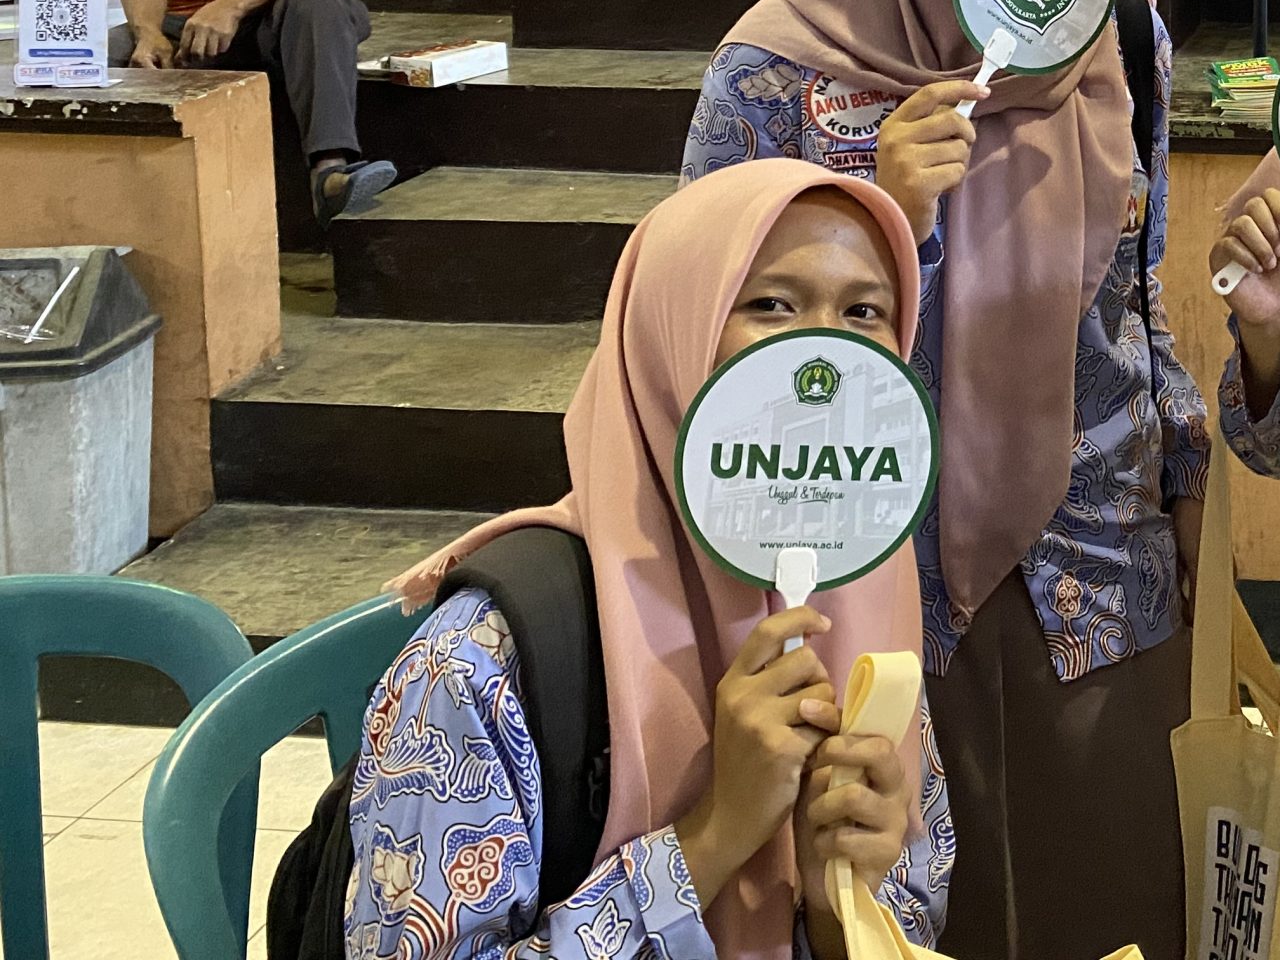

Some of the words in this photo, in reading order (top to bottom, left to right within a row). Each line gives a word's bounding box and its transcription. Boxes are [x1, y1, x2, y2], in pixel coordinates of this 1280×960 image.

[815, 93, 847, 117] AKU
[710, 442, 903, 483] UNJAYA
[800, 486, 809, 499] &
